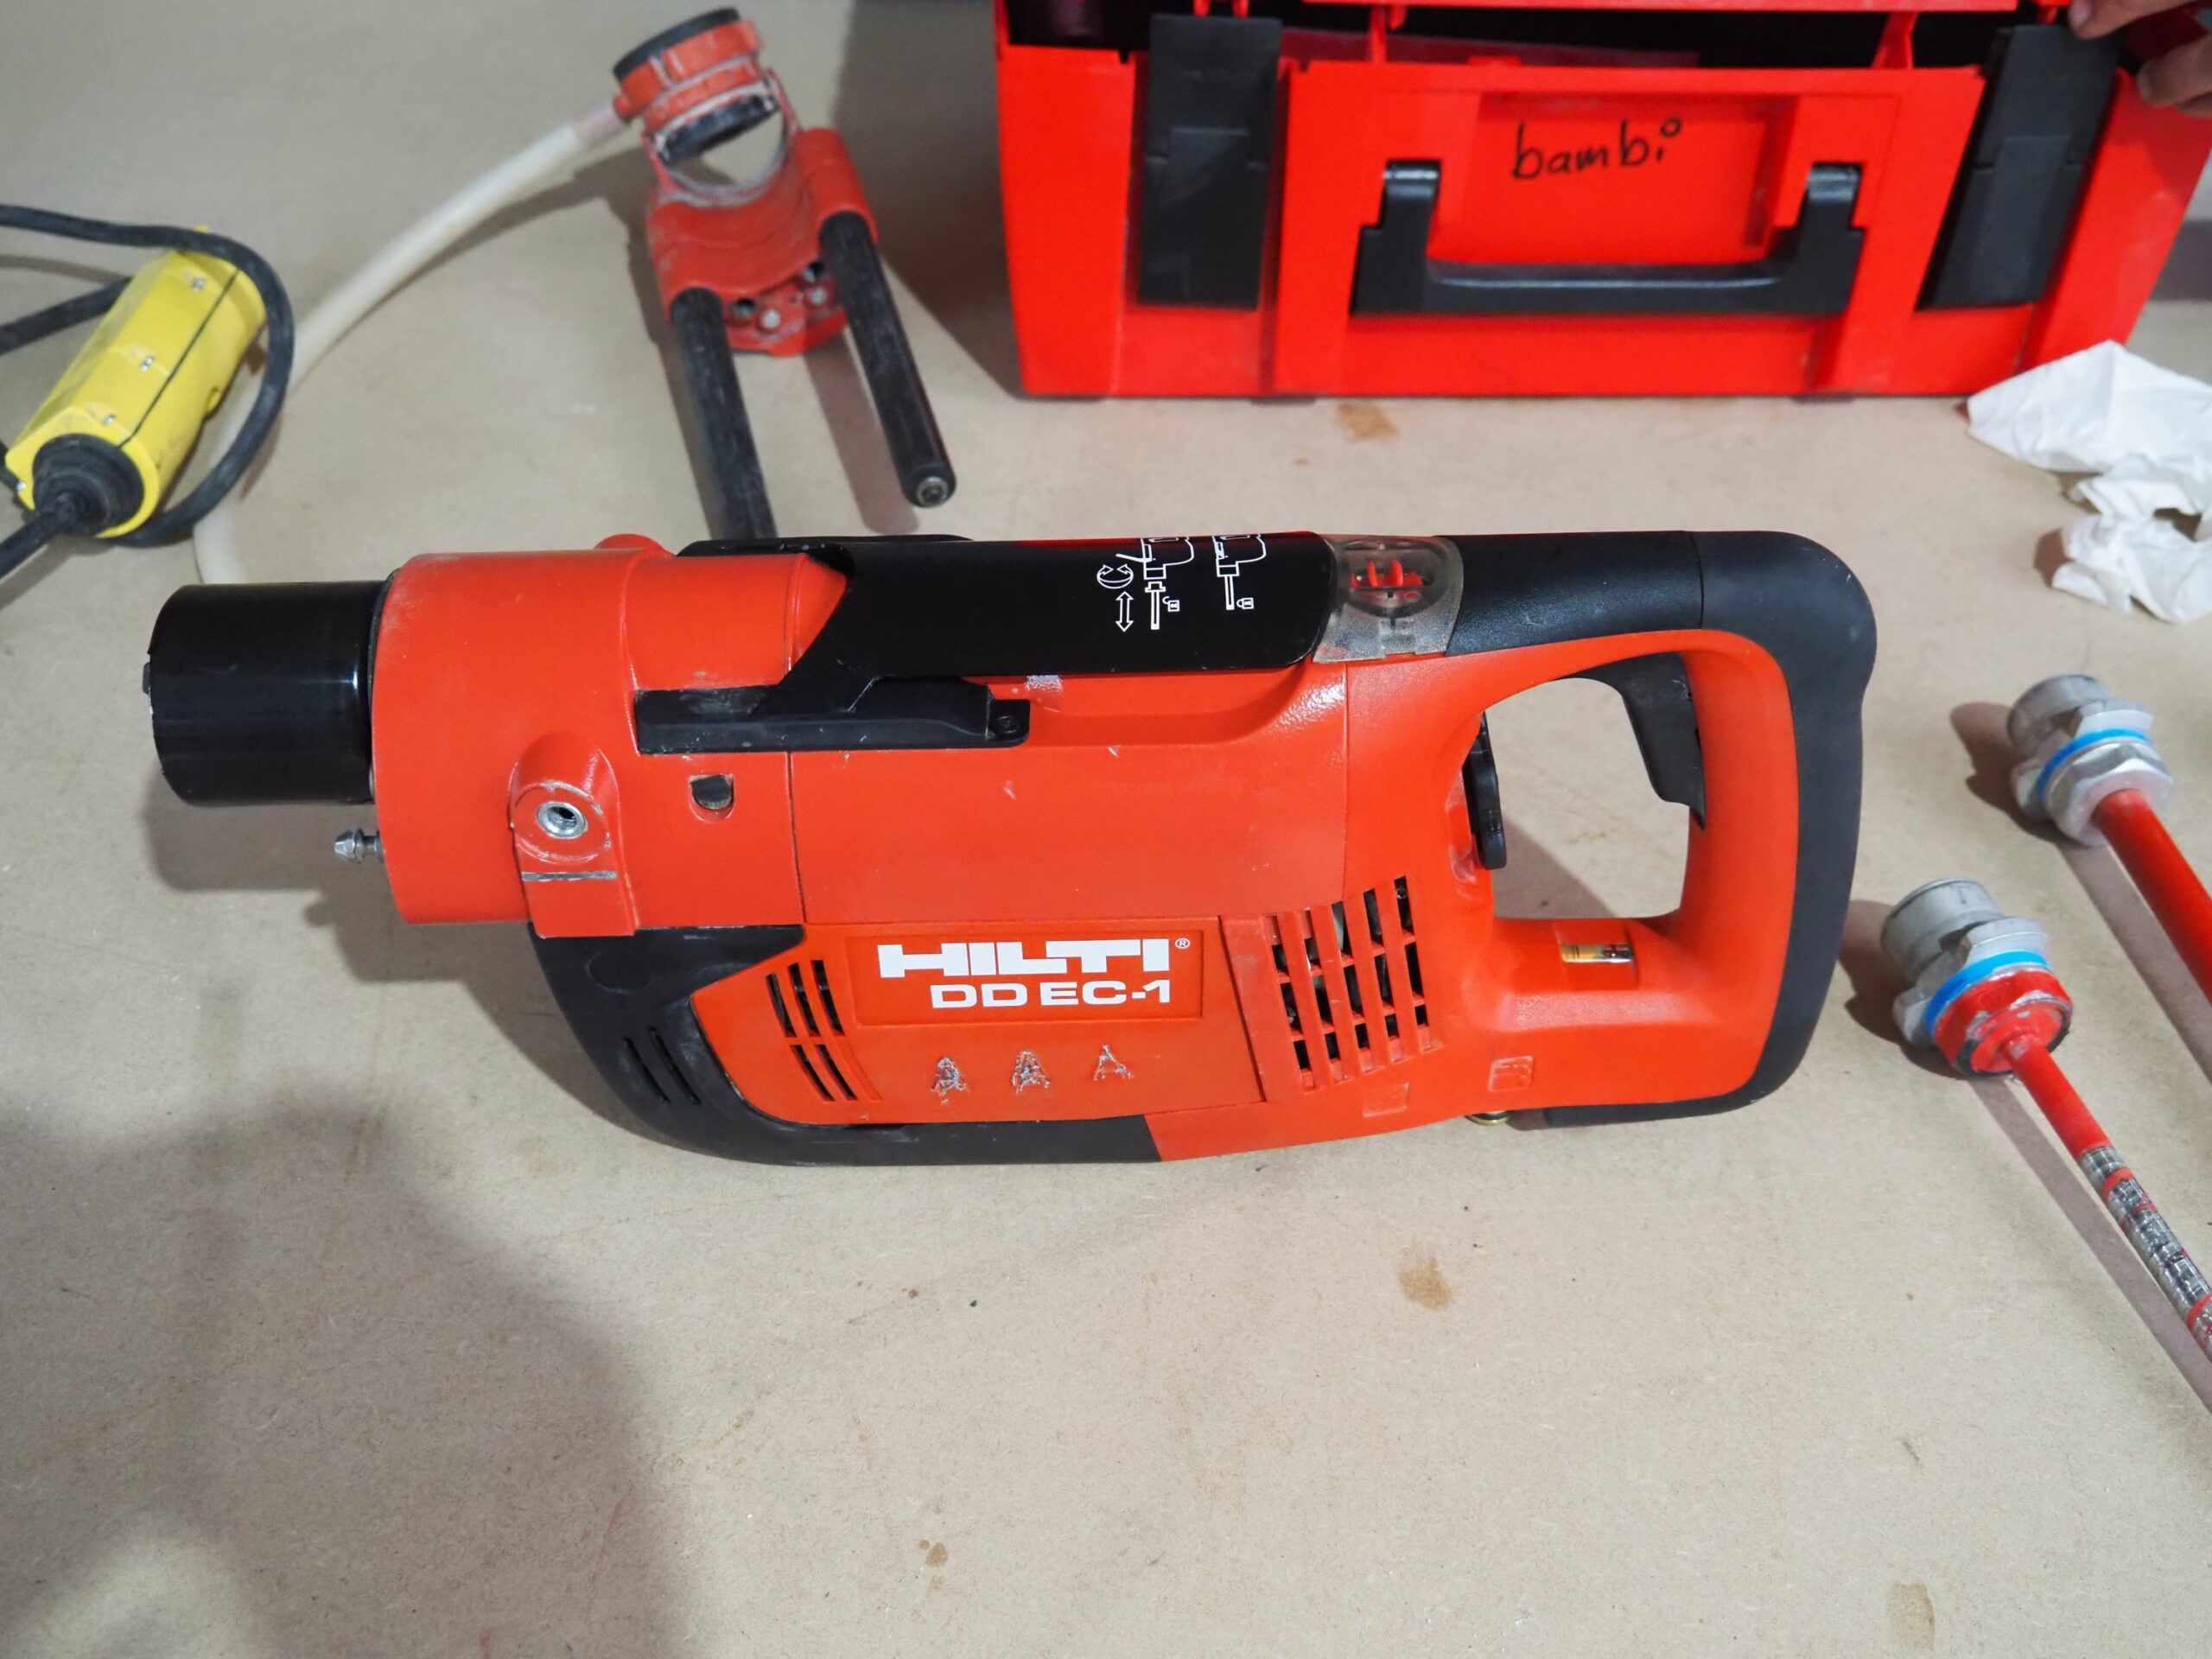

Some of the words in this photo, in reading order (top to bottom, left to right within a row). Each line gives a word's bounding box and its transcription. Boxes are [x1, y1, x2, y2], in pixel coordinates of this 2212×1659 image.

[1512, 118, 1682, 179] bambi
[877, 938, 1170, 978] HILTI
[930, 982, 1028, 1008] DD
[1039, 979, 1170, 1005] EC-1
